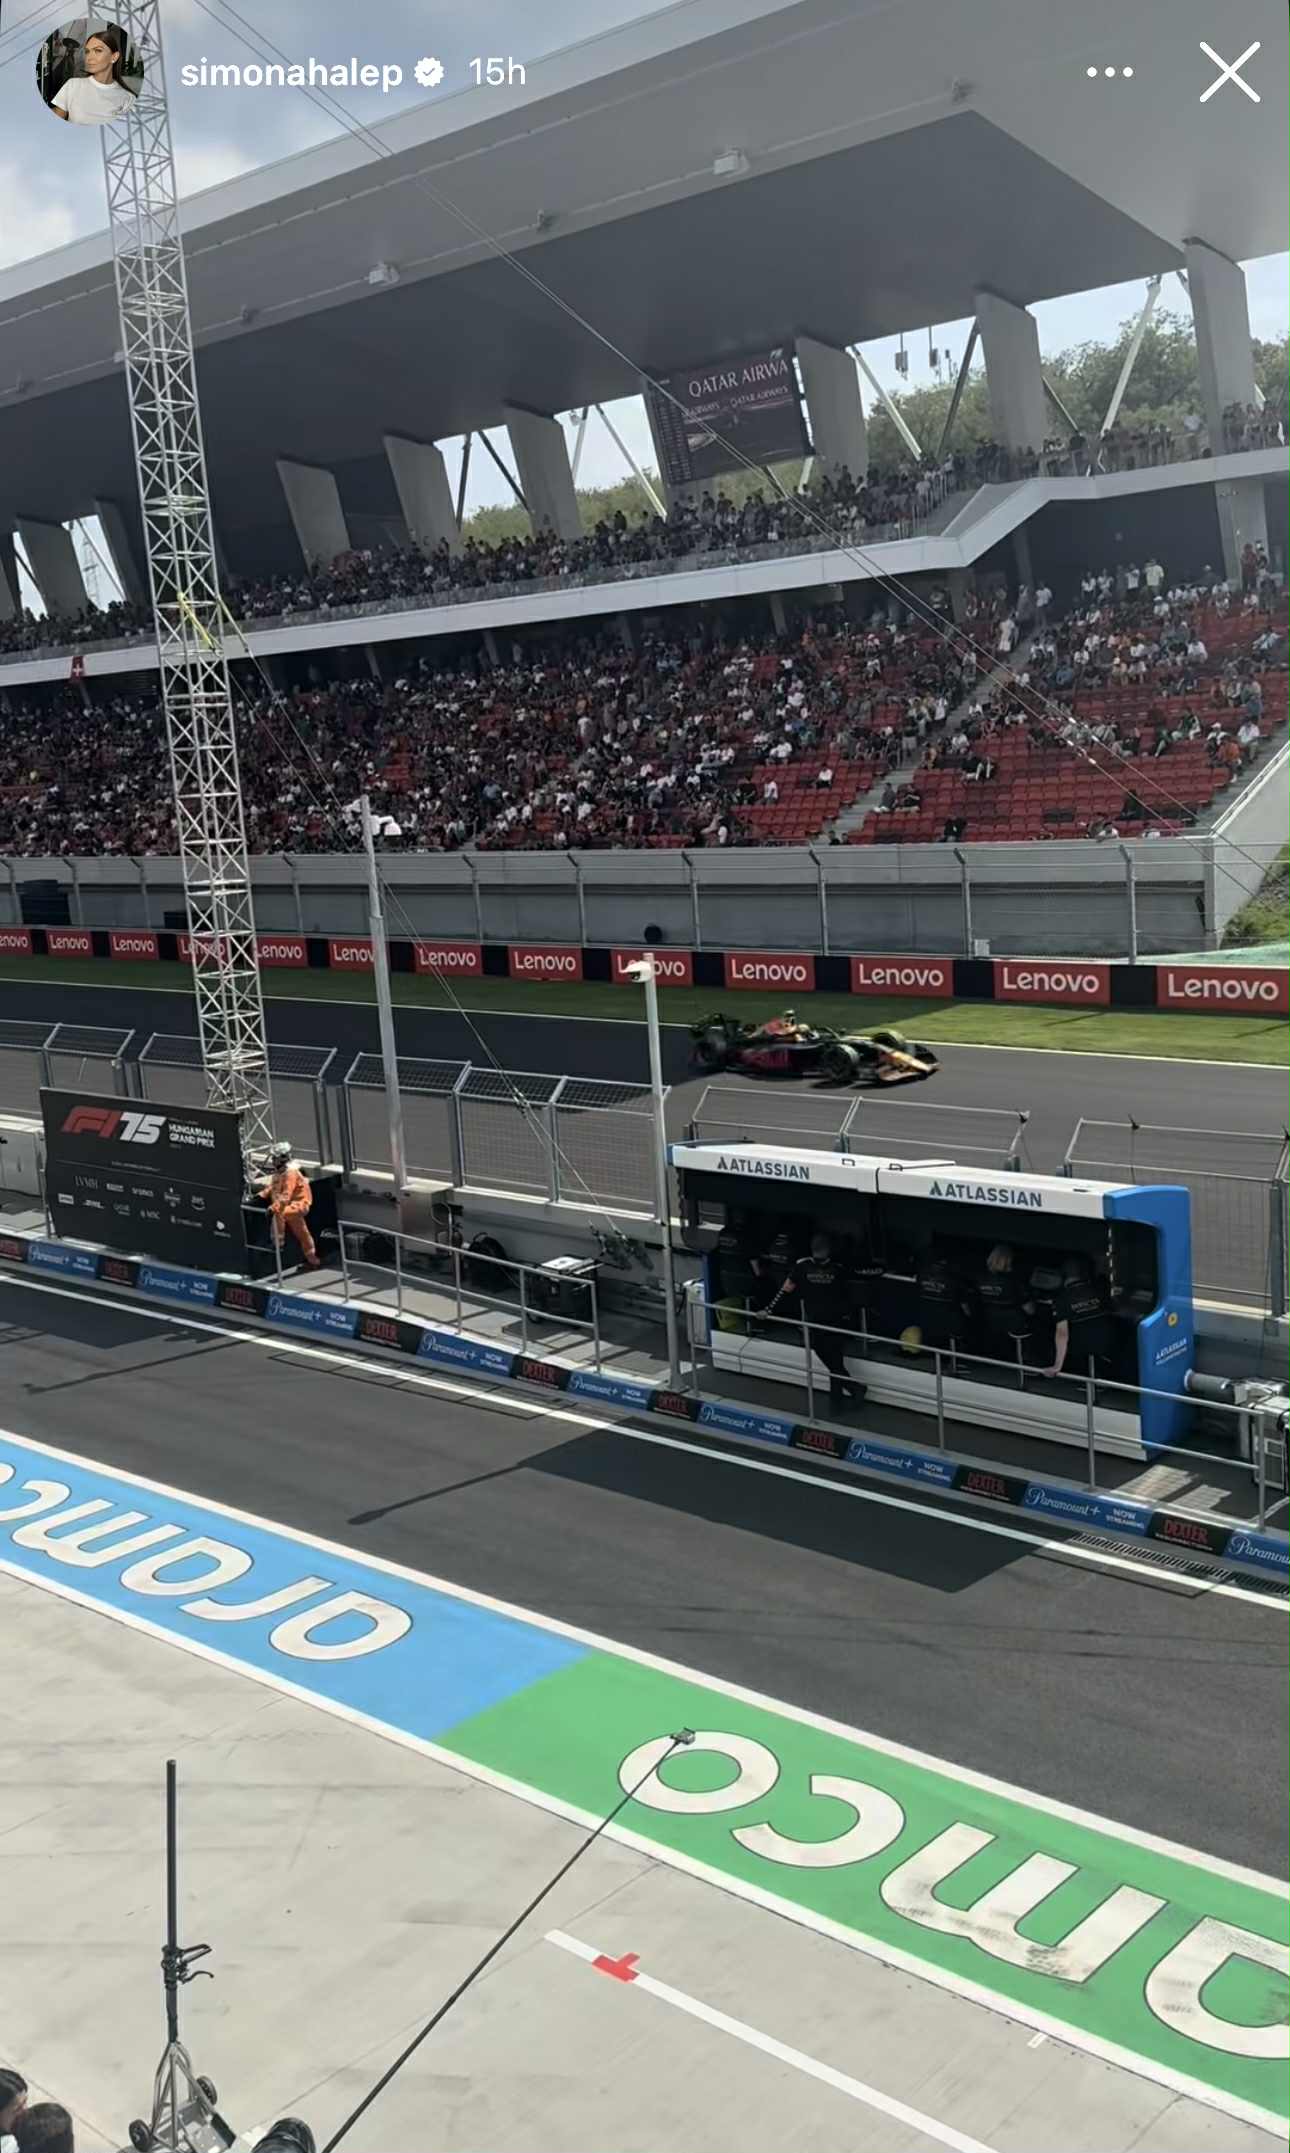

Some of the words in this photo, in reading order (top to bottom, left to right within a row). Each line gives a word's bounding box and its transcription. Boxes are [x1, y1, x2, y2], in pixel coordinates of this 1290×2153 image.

[689, 372, 738, 398] QATAR
[49, 935, 89, 950] Lenovo
[112, 936, 154, 953] Lenovo
[333, 944, 378, 963] Lenov
[419, 948, 476, 967] Lenovo
[514, 951, 577, 971] Lenovo
[618, 954, 686, 977] Lovo
[731, 958, 807, 982] Lenovo
[860, 963, 945, 988] Lenovo
[1003, 967, 1101, 994] Lenovo
[1167, 972, 1280, 1002] Lenovo
[169, 1124, 215, 1138] HUNGARIAN
[730, 1159, 810, 1181] ATLASSIAN
[945, 1183, 1043, 1208] ATLASSIAN
[268, 1295, 321, 1321] Paramount+
[850, 1442, 913, 1469] Paramount+
[968, 1472, 1005, 1494] DEXTER
[1027, 1488, 1101, 1517] Paramount+
[1113, 1508, 1136, 1520] NOW
[1163, 1519, 1208, 1544] DEXTER
